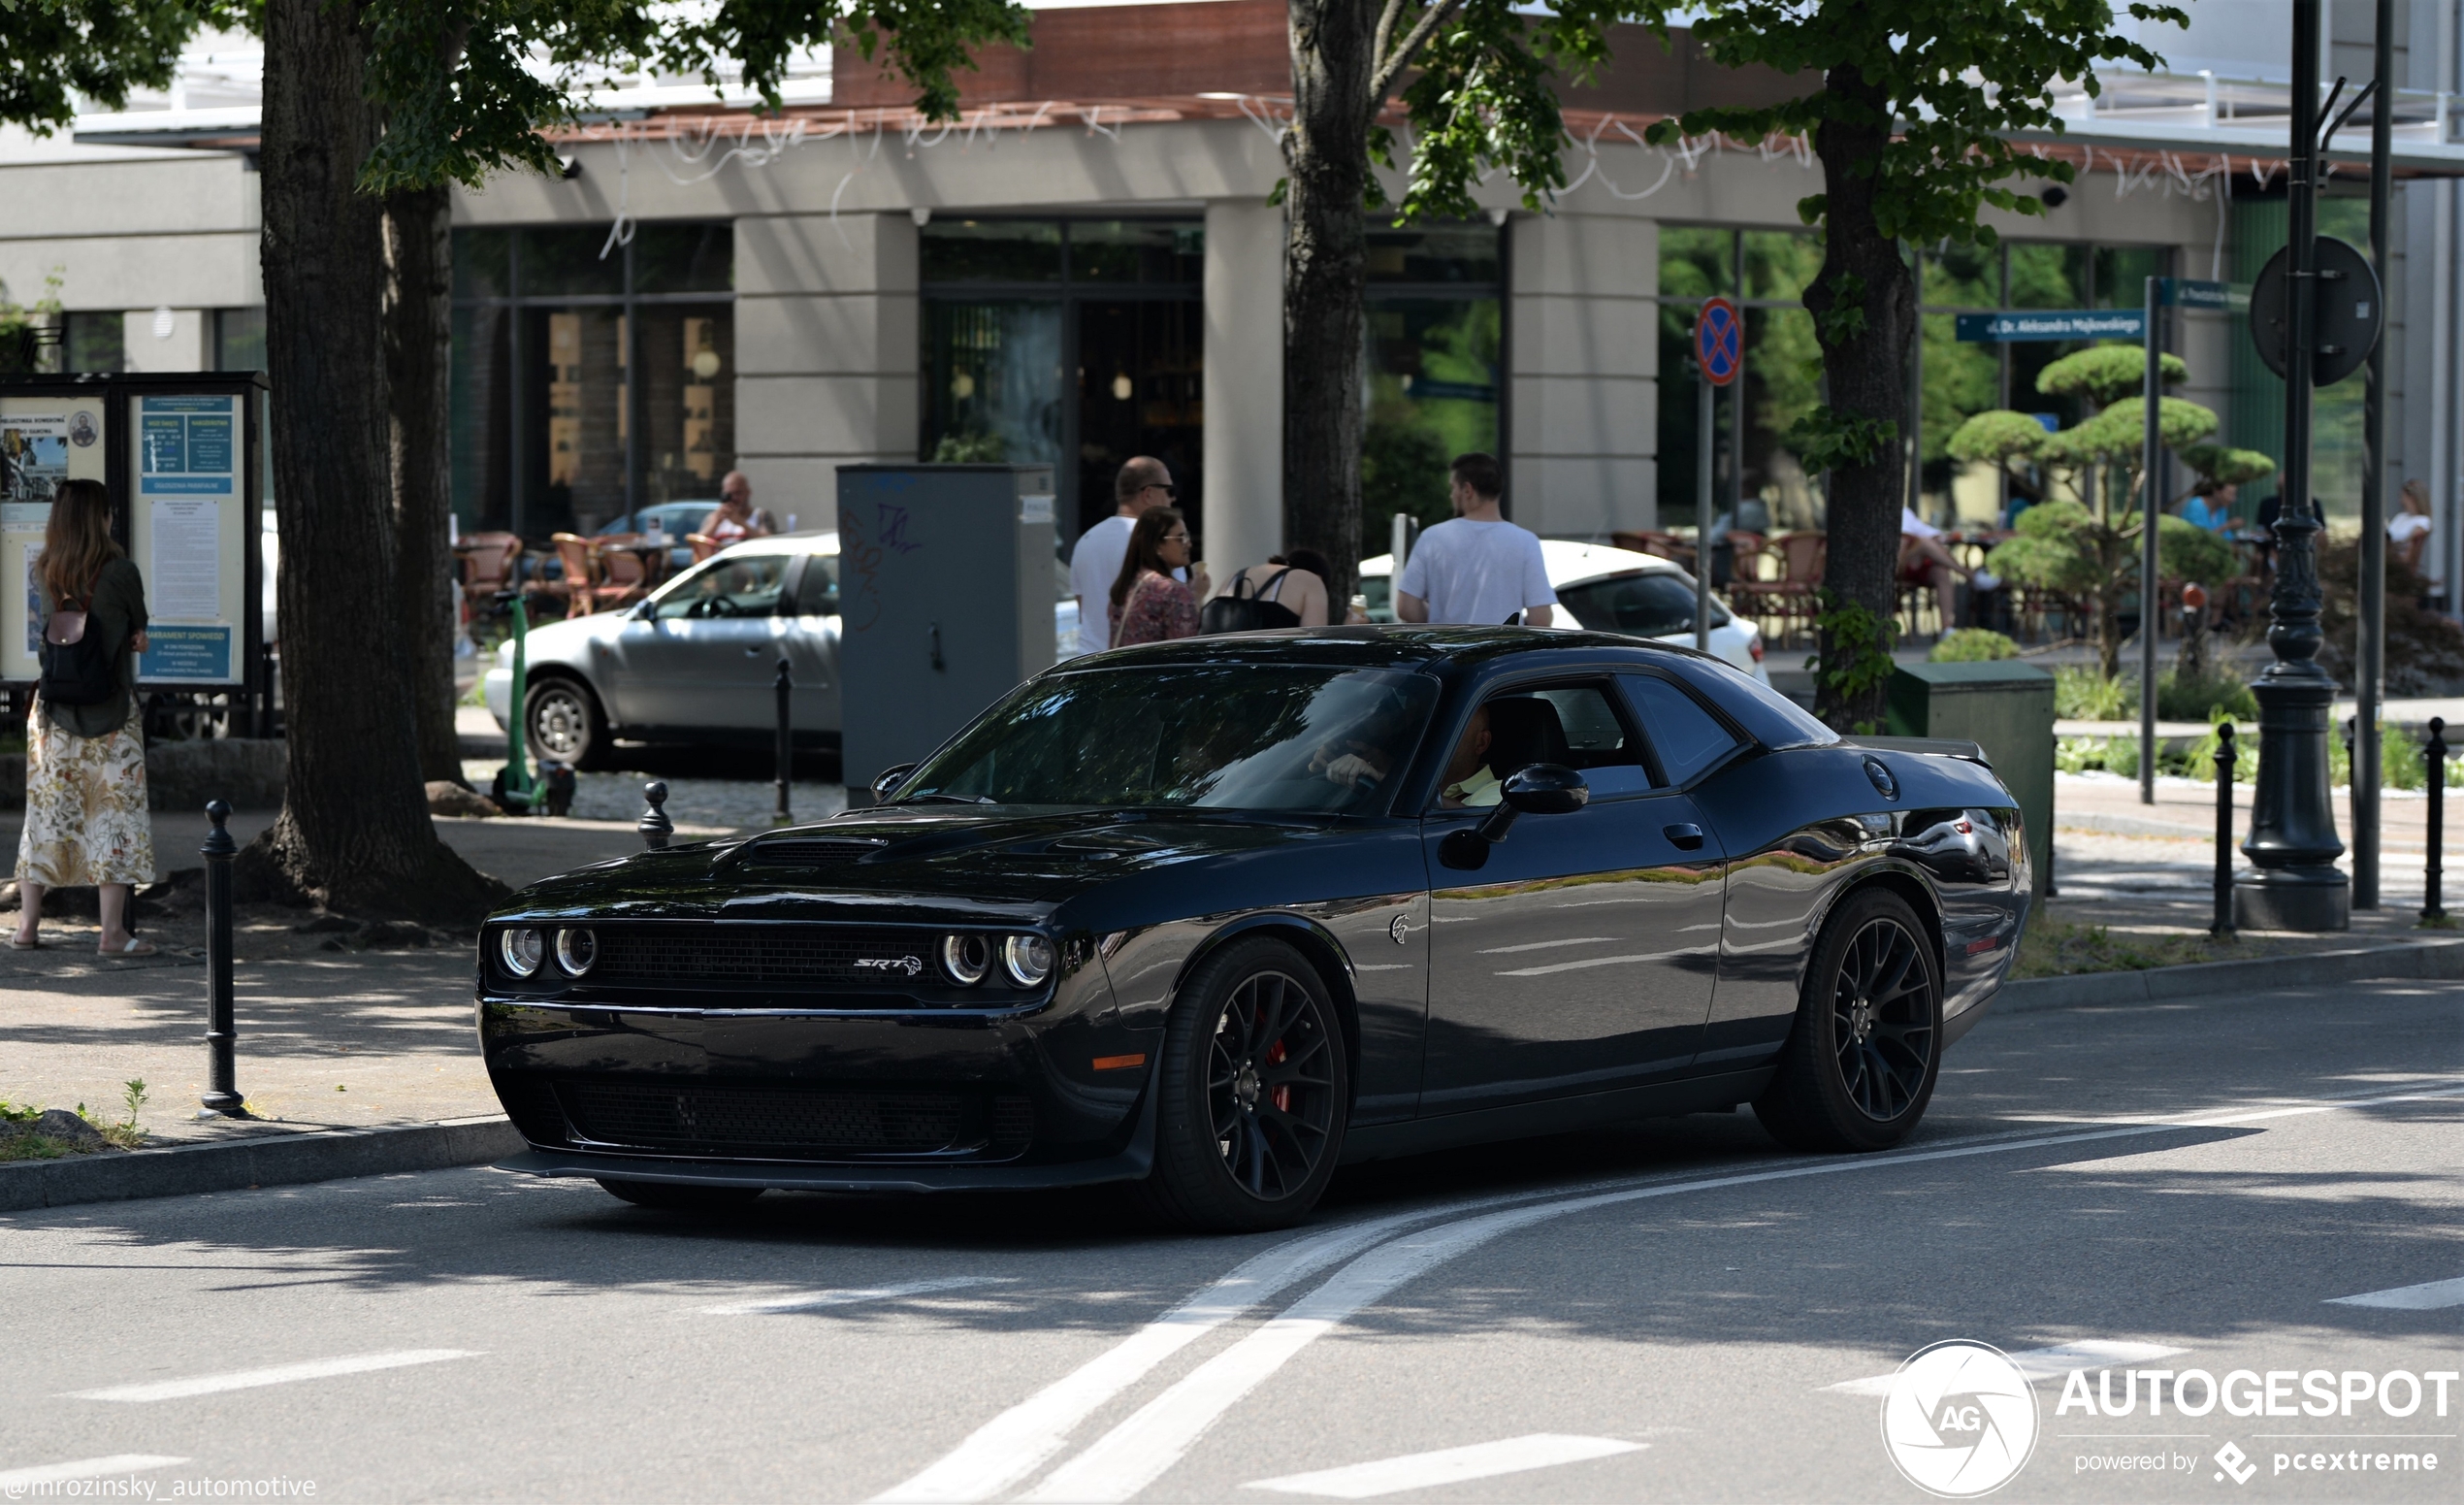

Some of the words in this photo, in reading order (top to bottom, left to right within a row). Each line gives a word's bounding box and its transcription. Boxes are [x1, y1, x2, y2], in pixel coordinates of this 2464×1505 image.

[2000, 319, 2016, 334] Dr.
[2017, 317, 2071, 333] Aleksandra
[2072, 316, 2141, 335] Majkowskiego
[854, 959, 908, 969] SRT
